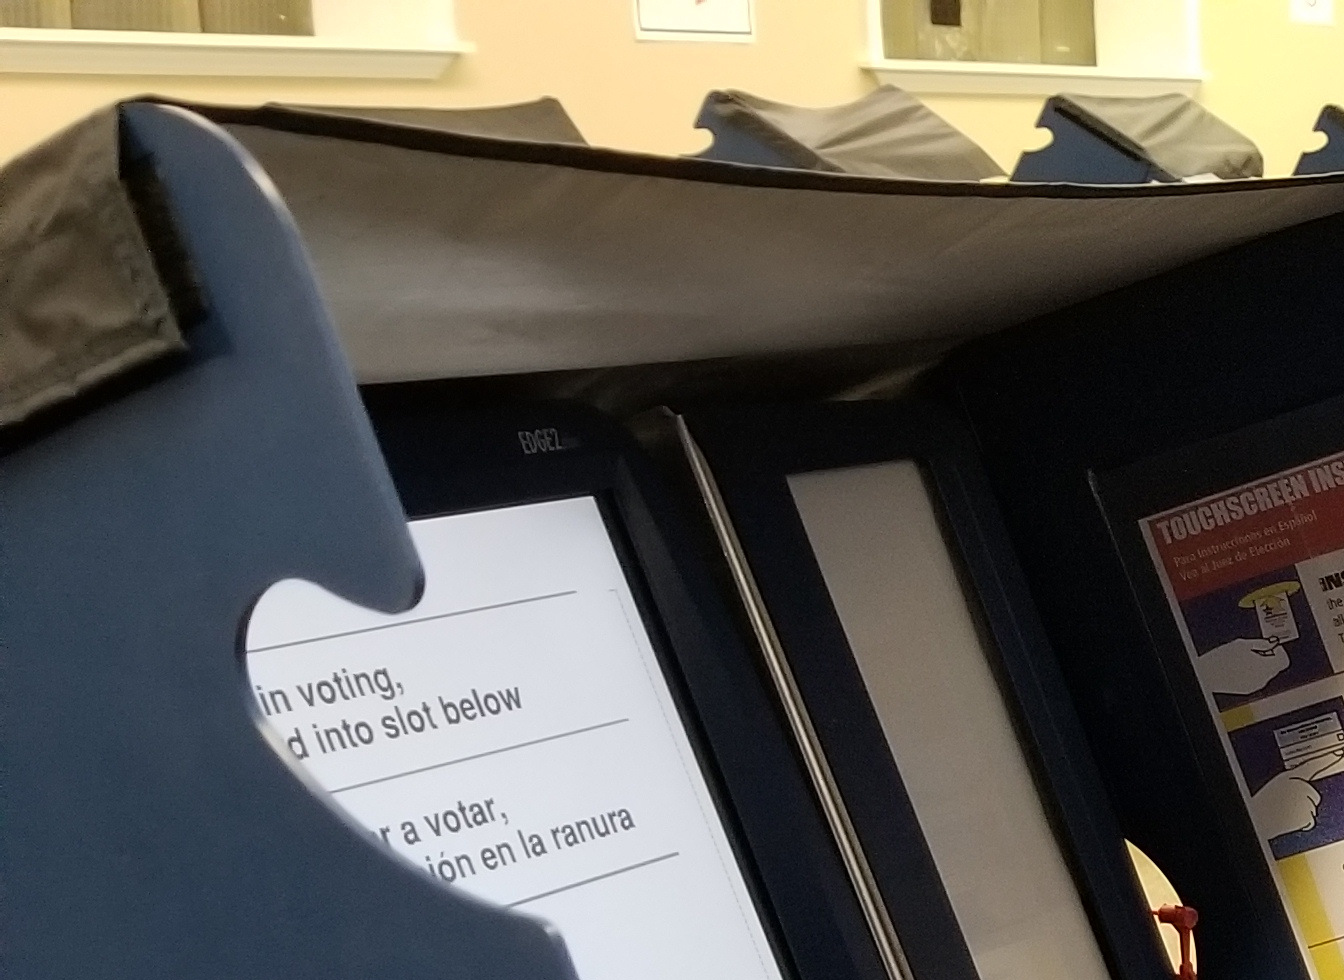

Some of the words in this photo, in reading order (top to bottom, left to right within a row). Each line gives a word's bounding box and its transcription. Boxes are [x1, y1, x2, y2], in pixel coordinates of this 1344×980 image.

[1157, 473, 1309, 544] TOUCHSCREEN
[296, 667, 404, 701] voting,
[312, 718, 374, 754] into
[380, 704, 438, 739] slot
[438, 686, 523, 725] below
[400, 819, 423, 845] a
[423, 797, 510, 838] votar,
[480, 841, 517, 871] en
[517, 829, 548, 859] la
[550, 807, 636, 850] ranura
